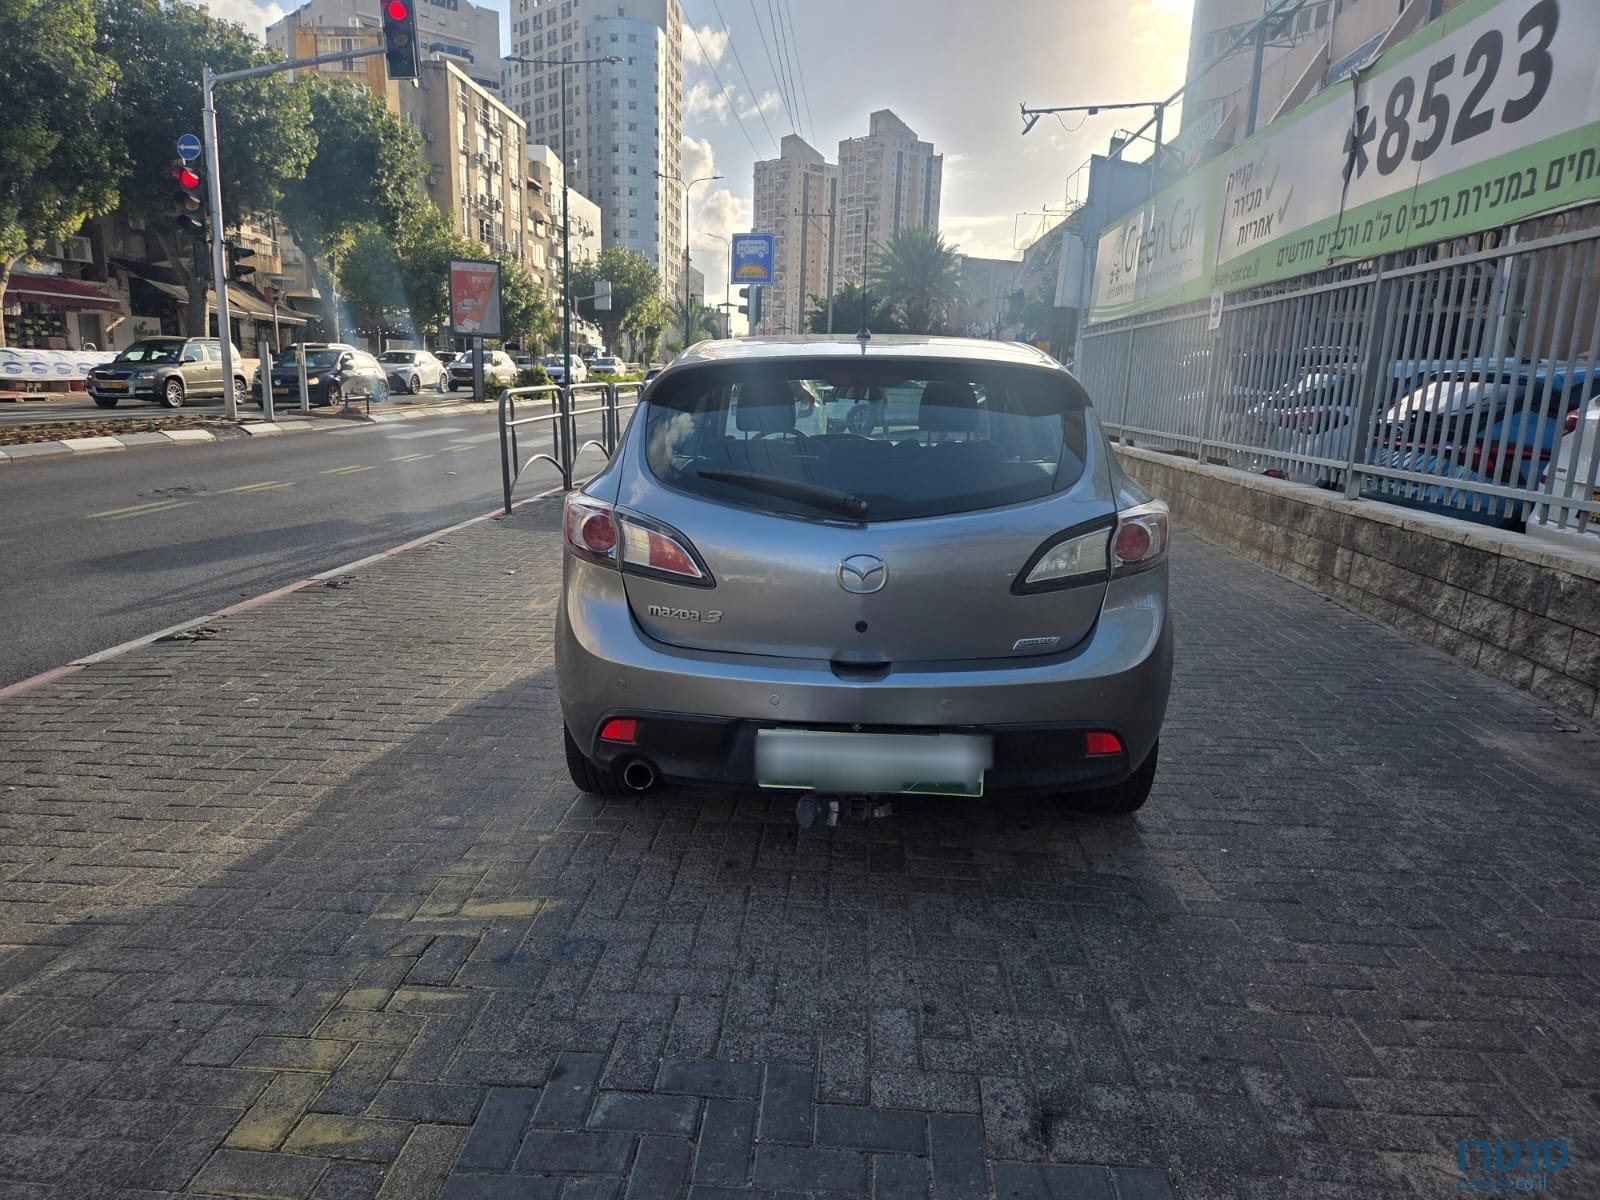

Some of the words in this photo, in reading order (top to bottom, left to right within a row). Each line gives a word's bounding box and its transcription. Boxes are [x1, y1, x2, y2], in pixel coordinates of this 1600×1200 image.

[1545, 146, 1600, 192] חים
[1232, 187, 1263, 218] מכירה
[1453, 166, 1538, 219] במכירת
[1125, 218, 1166, 273] Green
[1169, 197, 1203, 253] Car
[1237, 212, 1274, 247] אחריות
[1276, 238, 1315, 268] חדשים
